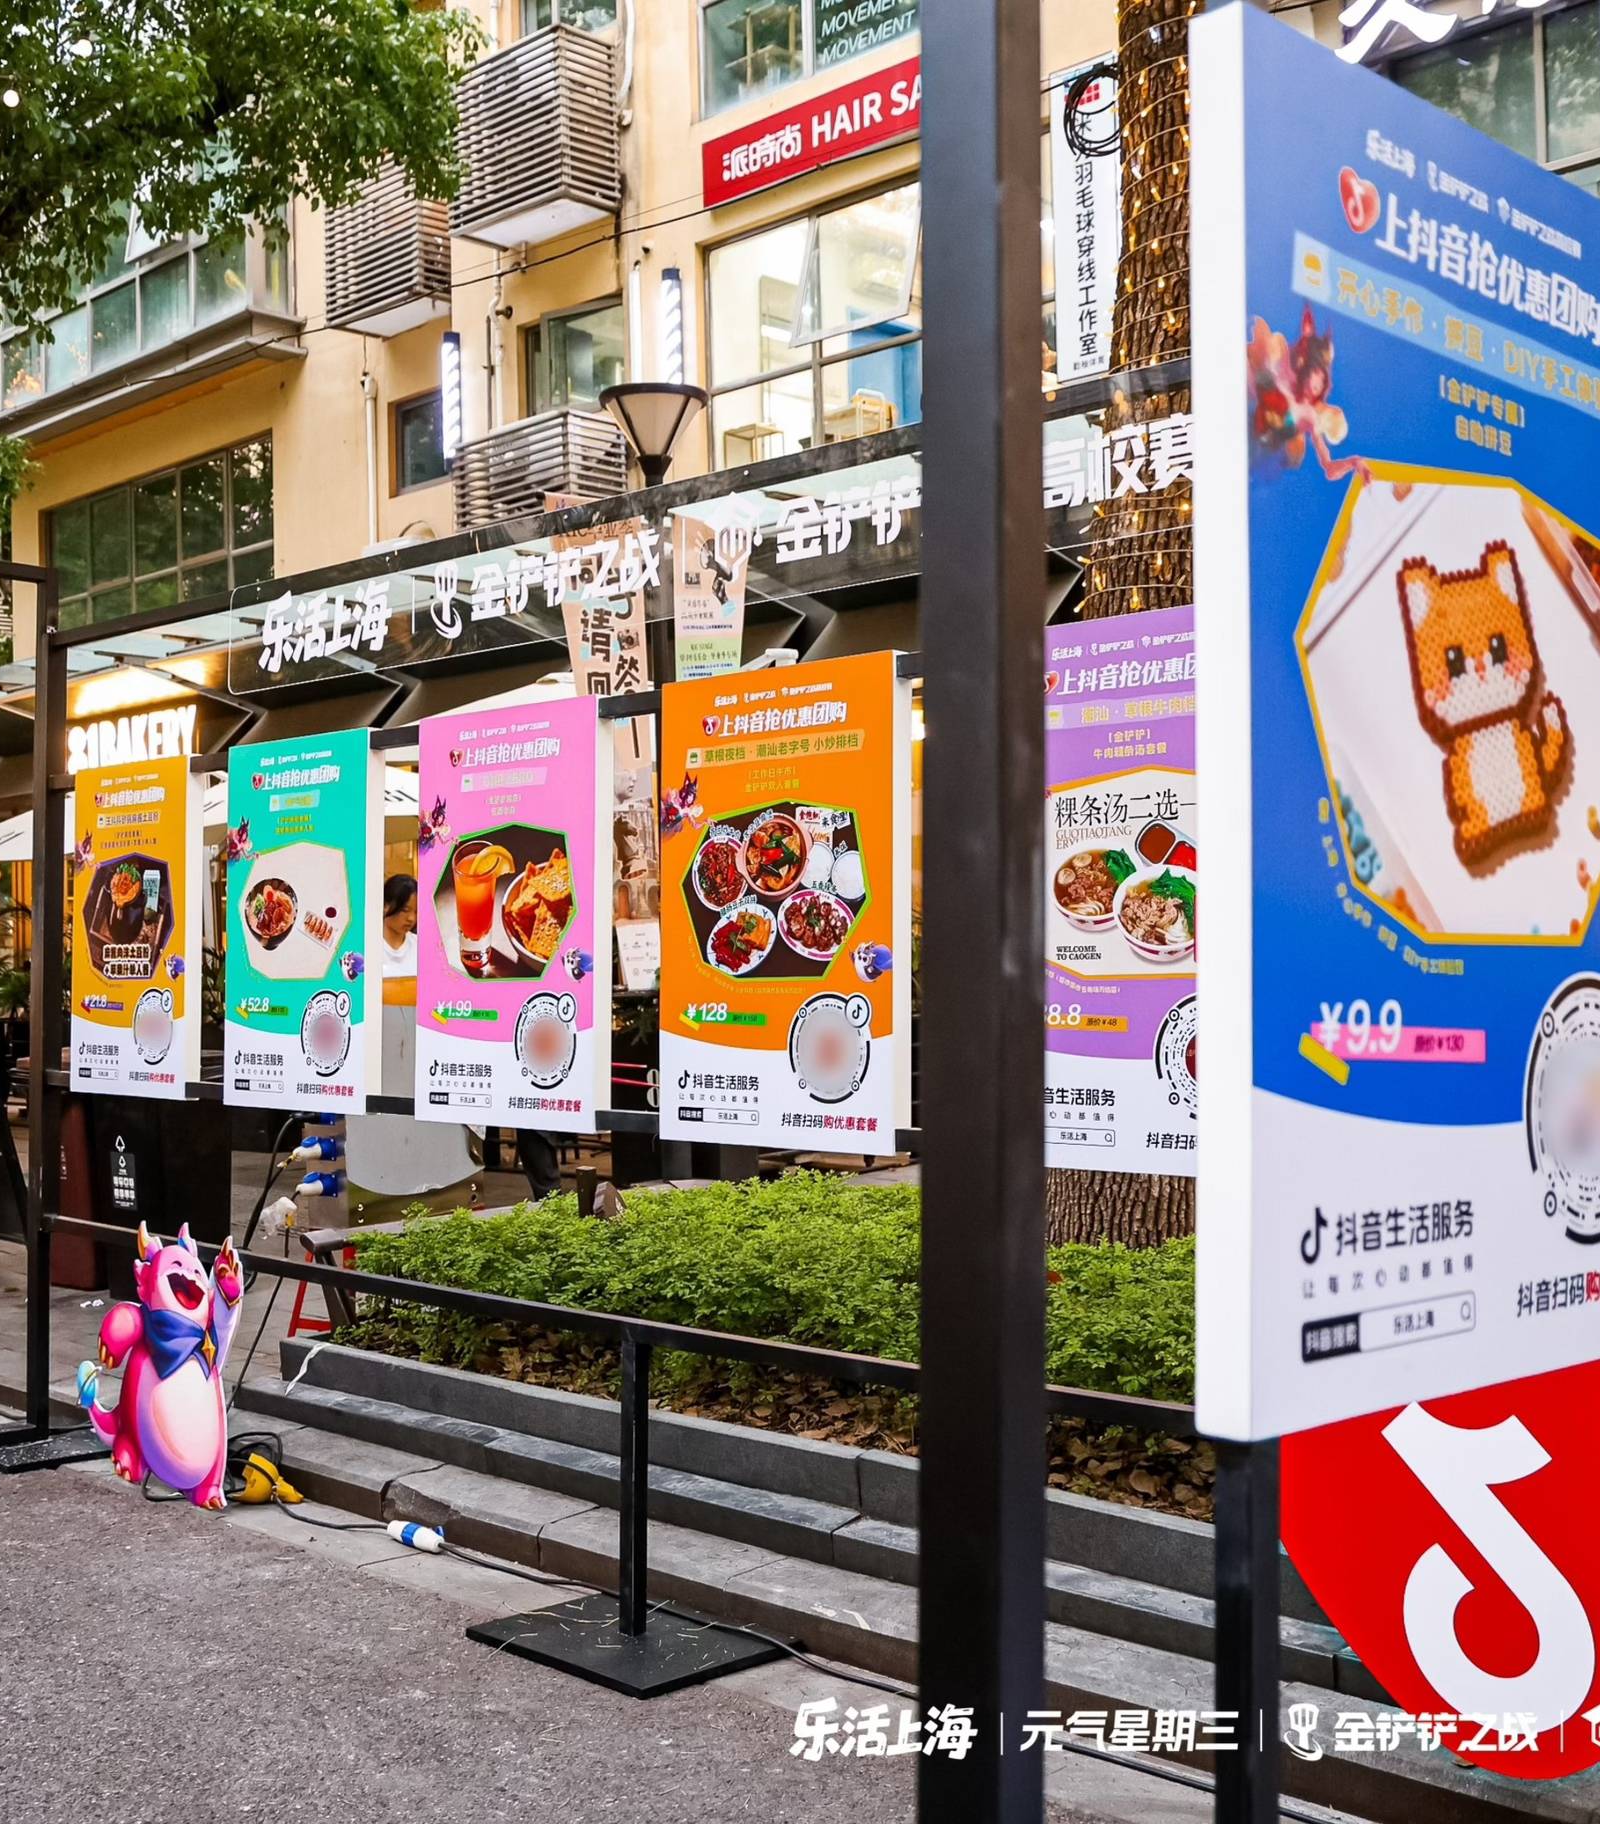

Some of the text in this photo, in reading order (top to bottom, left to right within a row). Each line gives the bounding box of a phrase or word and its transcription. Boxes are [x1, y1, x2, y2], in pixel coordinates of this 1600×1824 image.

[823, 9, 916, 65] MOVEMENT
[811, 89, 883, 148] HAIR
[259, 578, 391, 673] 乐活上海
[719, 701, 848, 738] 上抖音抢优惠团购
[461, 737, 561, 768] 上抖音抢优惠团购
[1056, 945, 1097, 953] WELCOME
[1056, 952, 1102, 961] TO CAOGEN
[687, 1002, 728, 1022] ¥128
[1319, 999, 1402, 1055] ¥9.9
[441, 1063, 493, 1078] 抖音生活服务
[692, 1072, 760, 1091] 抖音生活服务
[781, 1112, 879, 1133] 抖音扫码购优惠套餐
[1335, 1198, 1475, 1258] 抖音生活服务
